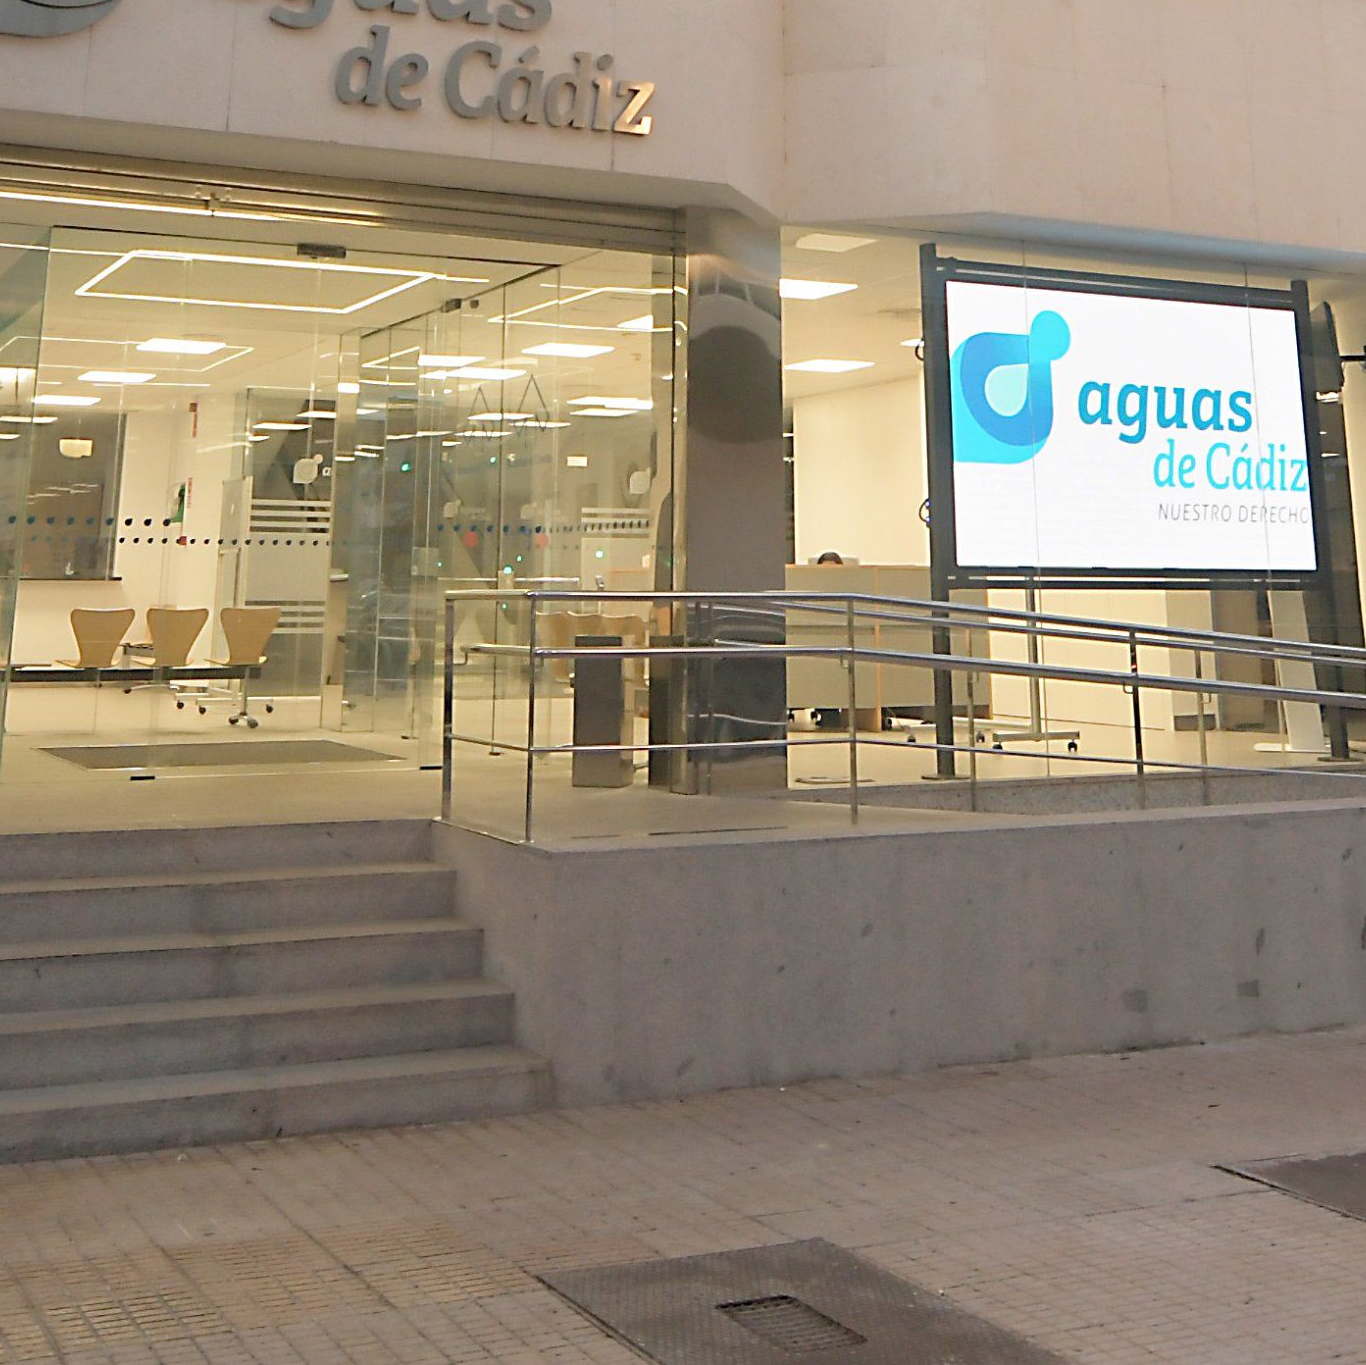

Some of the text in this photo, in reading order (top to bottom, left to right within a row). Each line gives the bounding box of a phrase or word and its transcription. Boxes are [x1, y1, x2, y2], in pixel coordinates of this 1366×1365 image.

[335, 25, 655, 136] de Cádiz
[1078, 381, 1253, 444] aguas
[1153, 438, 1309, 492] de Cádiz
[1158, 503, 1310, 524] NUESTRO DERECHO
